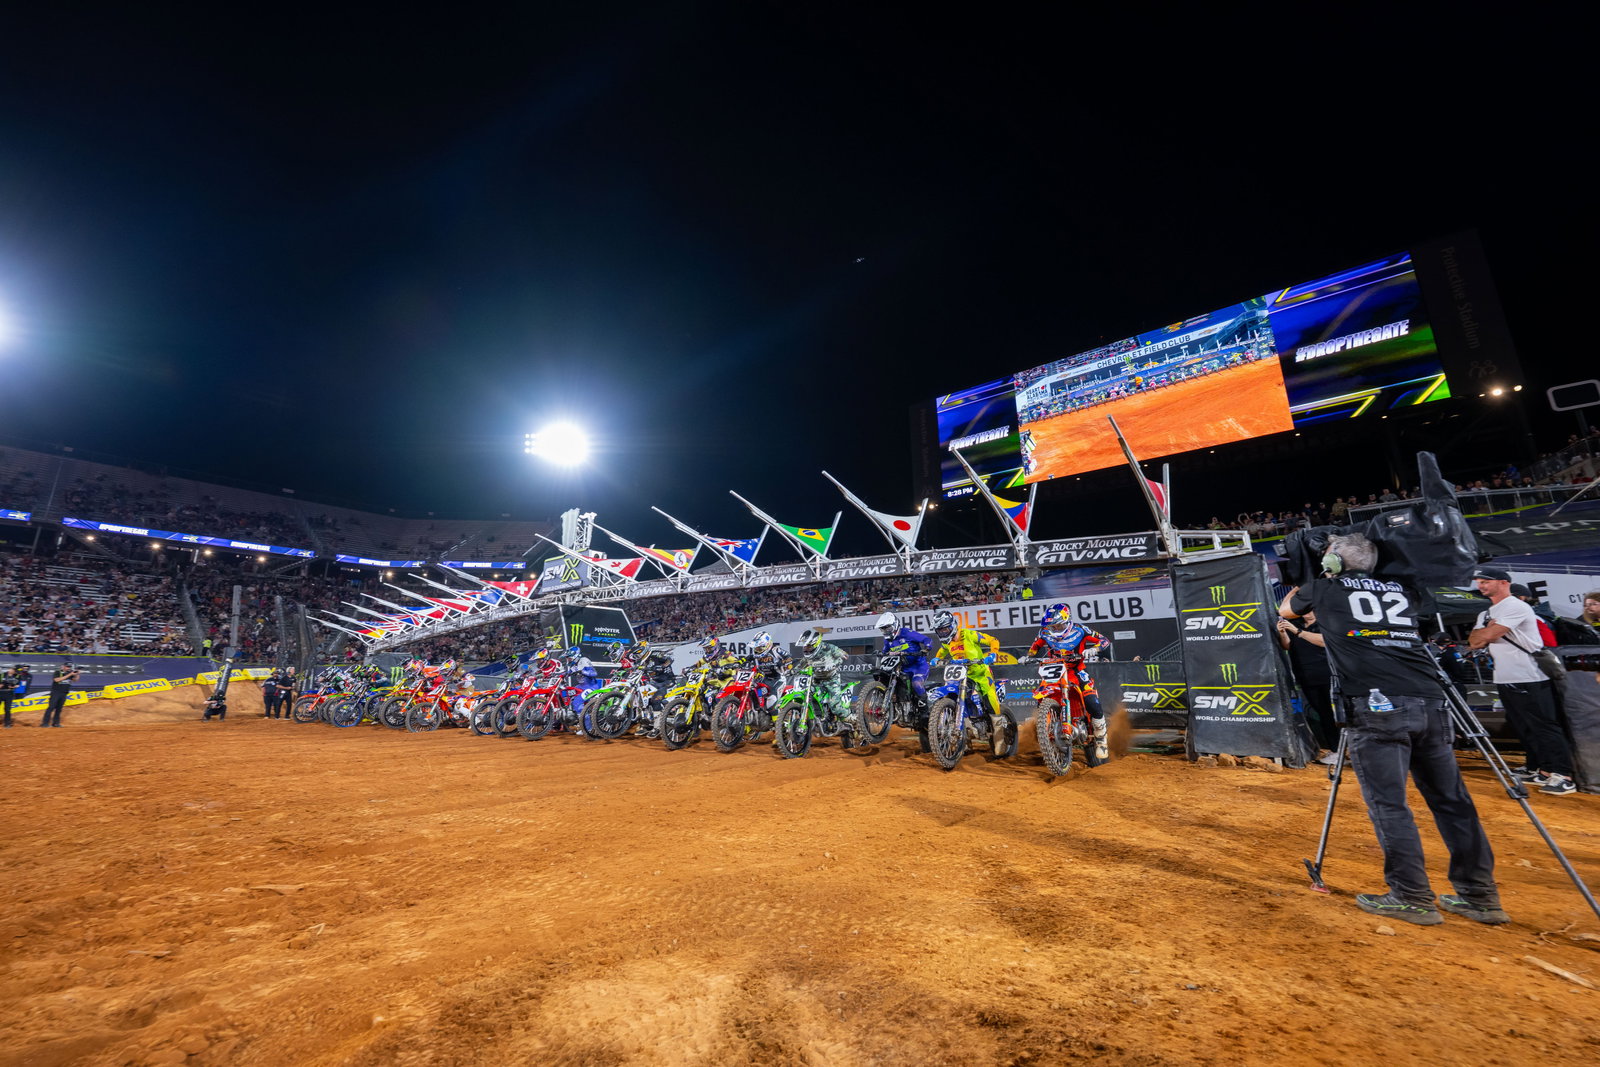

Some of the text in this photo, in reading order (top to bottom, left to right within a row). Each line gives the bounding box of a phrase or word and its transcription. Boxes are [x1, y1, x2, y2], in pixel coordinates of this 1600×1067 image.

[1144, 342, 1167, 355] FIELD
[1168, 334, 1191, 348] CLUB
[1295, 319, 1409, 362] #DROPTHEGATE
[947, 487, 973, 498] 8:28 PM
[1051, 536, 1147, 552] ROCKY MOUNTAIN
[858, 557, 897, 567] MOUNTAIN
[931, 549, 1007, 560] ROCKY MOUNTAIN
[543, 558, 580, 583] SMX
[1078, 596, 1144, 621] CLUB
[1348, 591, 1412, 626] 02
[1184, 608, 1258, 634] SMX
[881, 656, 899, 667] 46
[738, 672, 751, 681] 12
[945, 666, 963, 680] 66
[1042, 665, 1064, 680] 3
[114, 680, 167, 693] SUZUKI
[10, 693, 81, 709] SUZKI
[1121, 687, 1188, 709] SMX
[1193, 690, 1270, 715] SMX
